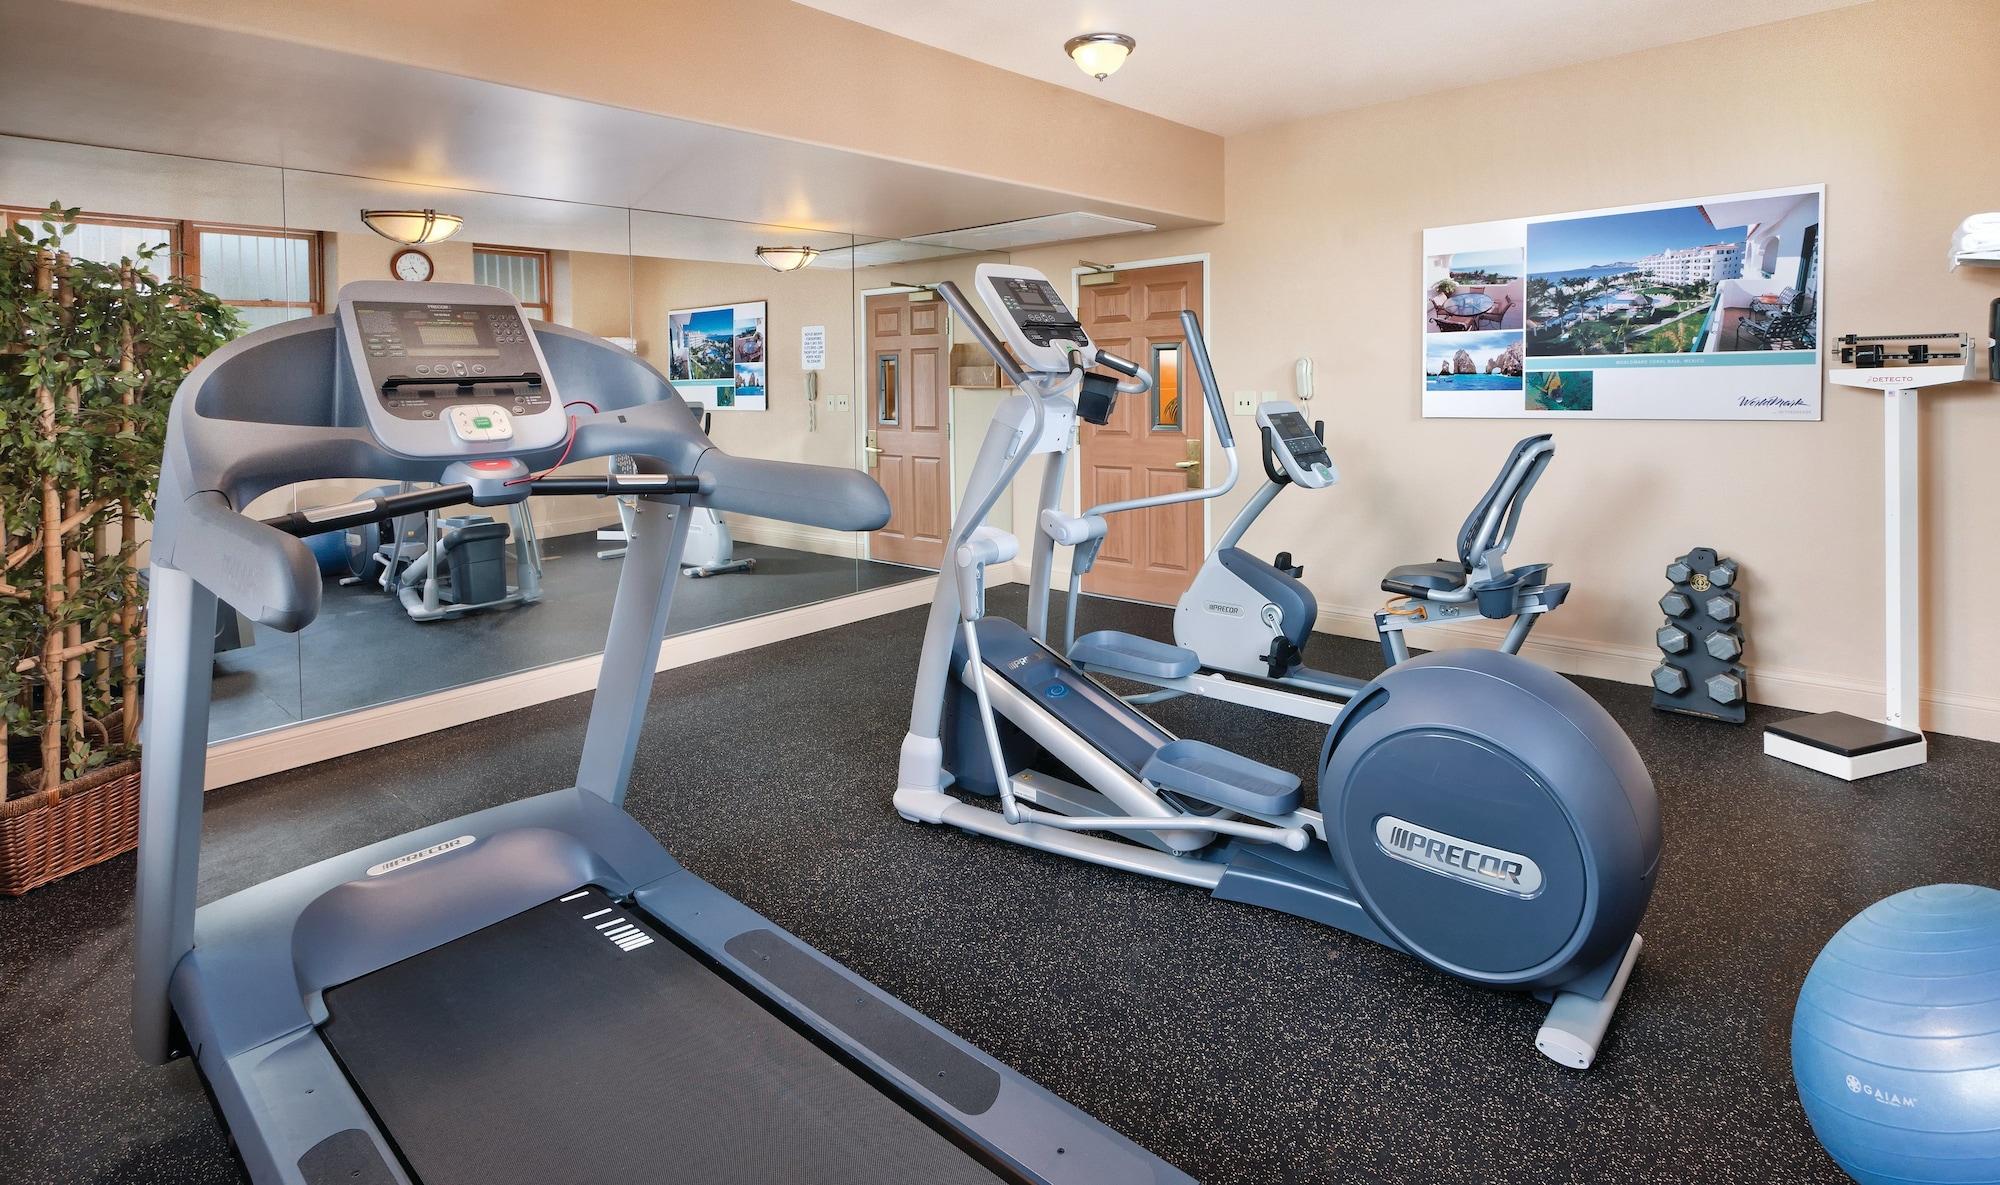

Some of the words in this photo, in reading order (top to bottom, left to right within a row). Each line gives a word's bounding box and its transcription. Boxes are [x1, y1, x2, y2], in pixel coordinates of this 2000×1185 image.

[1738, 396, 1811, 408] WorldMark
[1212, 604, 1239, 614] PRECOR
[1406, 831, 1523, 886] PRECOR
[1863, 1084, 1915, 1108] GAIAM
